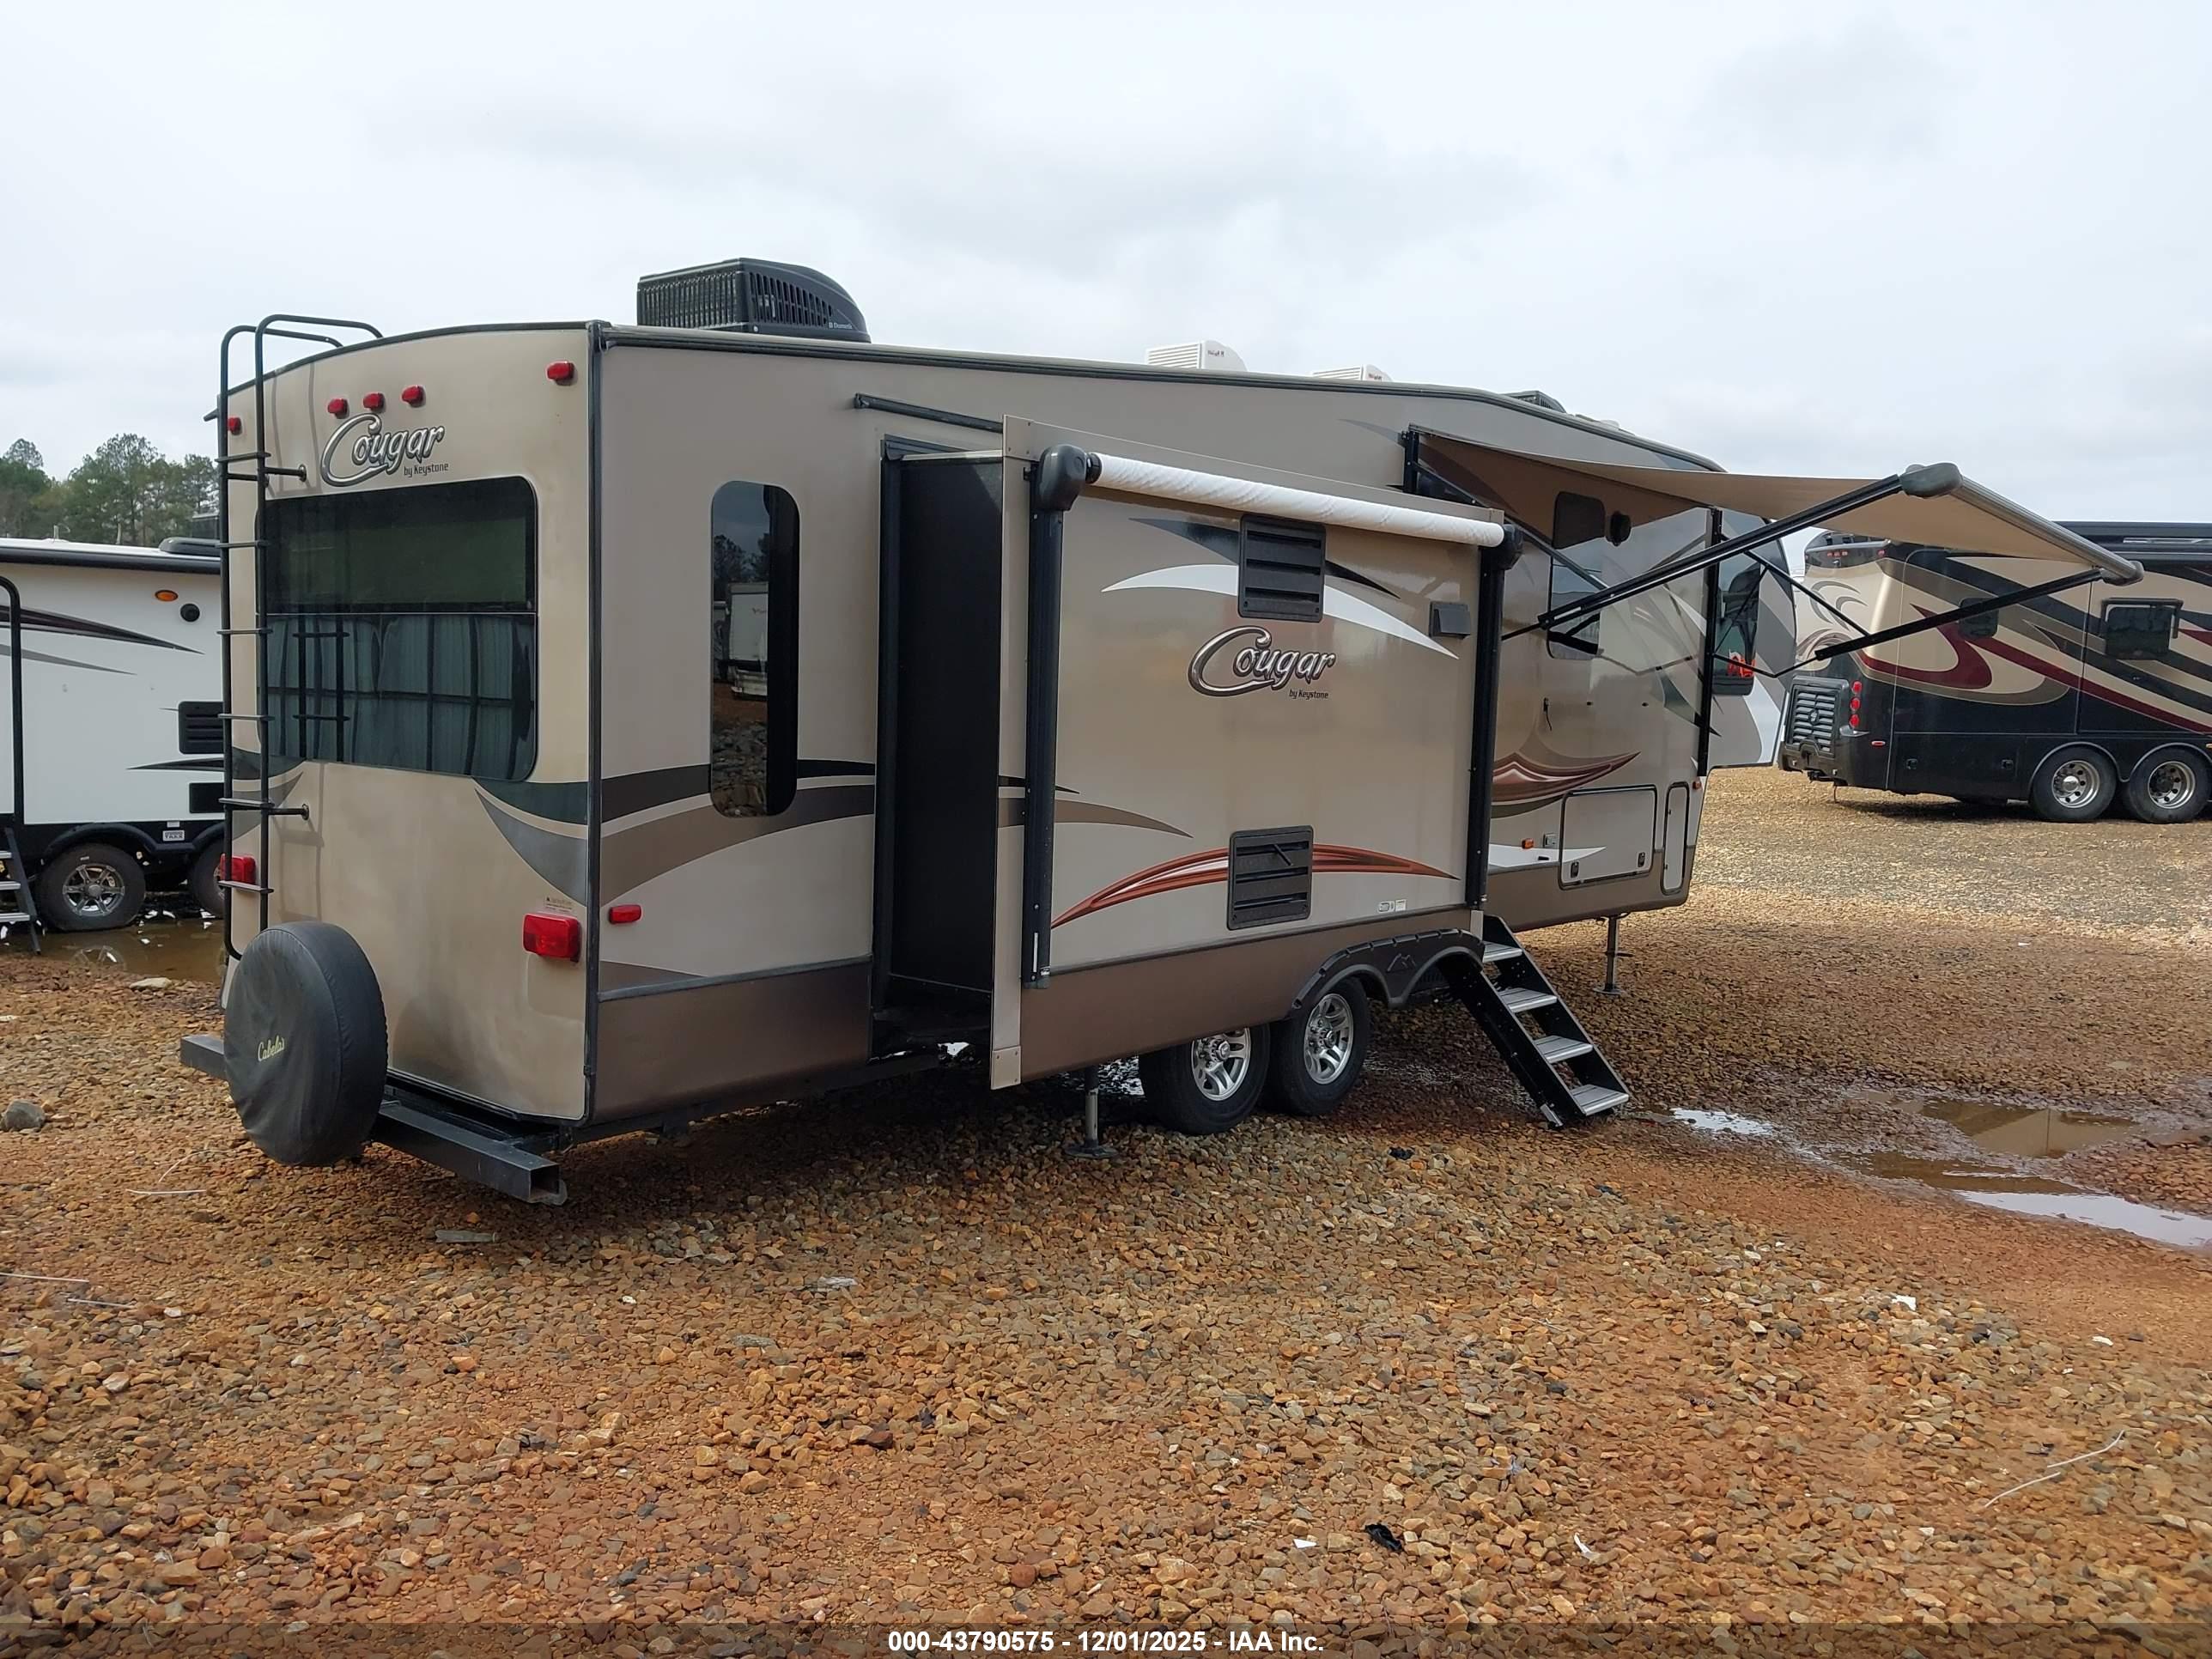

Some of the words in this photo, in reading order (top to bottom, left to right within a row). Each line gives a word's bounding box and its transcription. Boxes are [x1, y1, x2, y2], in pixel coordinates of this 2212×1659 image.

[320, 412, 445, 487] Cougar
[404, 466, 413, 477] by
[414, 462, 449, 477] Keystone
[1188, 625, 1336, 696] Cougar
[1289, 690, 1297, 699] by
[1298, 689, 1328, 700] Keystone
